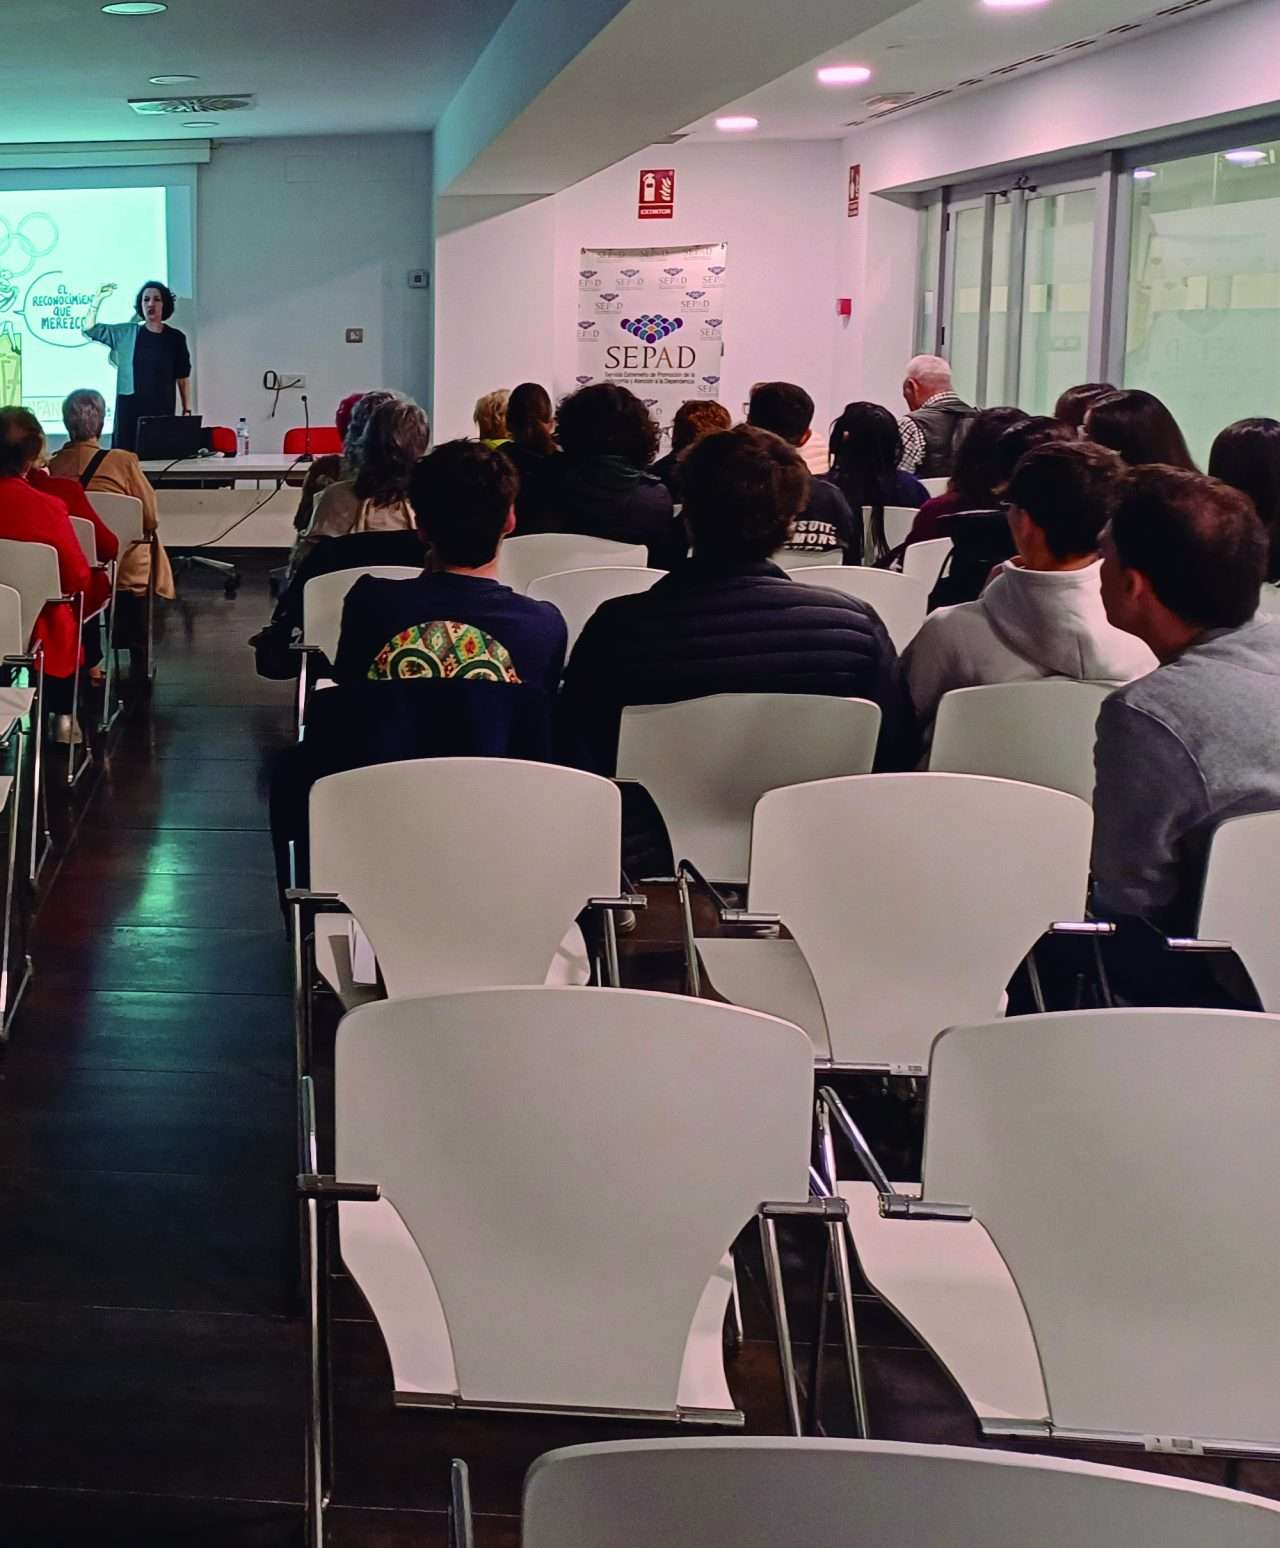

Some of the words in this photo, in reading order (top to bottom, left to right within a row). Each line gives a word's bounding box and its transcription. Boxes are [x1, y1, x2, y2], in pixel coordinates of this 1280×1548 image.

[57, 285, 67, 295] EL
[33, 294, 96, 306] RECONOCIMIEN
[53, 306, 71, 317] QUE
[605, 345, 696, 369] SEPAD
